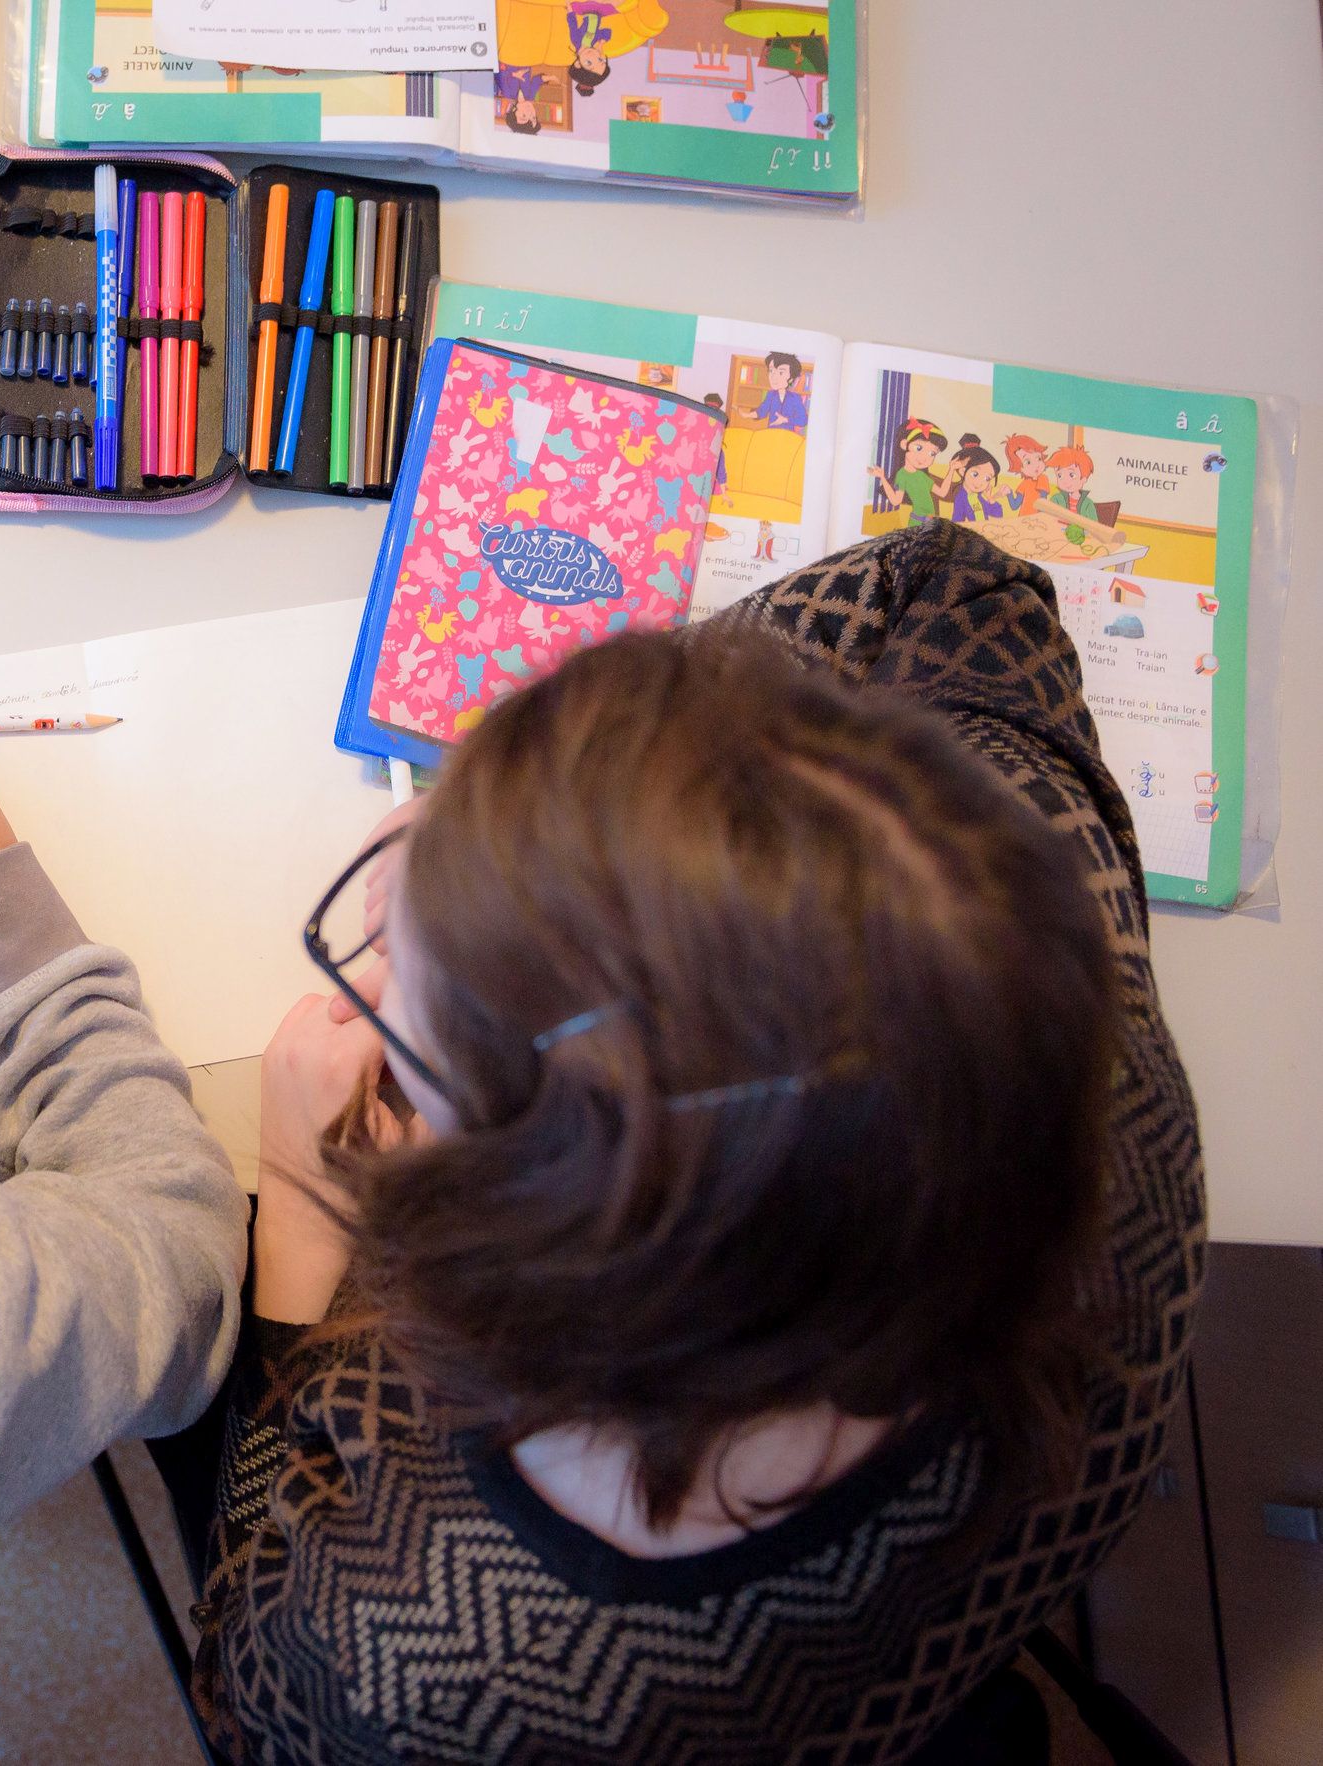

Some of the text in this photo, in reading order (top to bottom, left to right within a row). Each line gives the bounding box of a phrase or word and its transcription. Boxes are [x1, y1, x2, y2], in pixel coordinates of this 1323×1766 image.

[370, 45, 409, 56] timpului
[413, 45, 467, 54] Măsurarea
[123, 61, 194, 71] ANIMALELE
[124, 103, 136, 121] â
[1176, 410, 1188, 430] â
[1116, 457, 1189, 476] ANIMALELE
[1125, 475, 1179, 491] PROIECT
[479, 521, 587, 565] Curious
[705, 556, 763, 571] e-mi-si-u-ne
[508, 558, 618, 594] animals
[711, 569, 754, 583] emisiune
[1087, 640, 1168, 661] Mar-ta Tra-ian
[1087, 654, 1166, 673] Marta Traian
[1087, 693, 1115, 705] pictat
[1119, 697, 1136, 708] trei
[1156, 700, 1179, 713] Lâna
[1183, 704, 1197, 715] lor
[1200, 708, 1207, 717] e
[1093, 706, 1201, 728] cântec despre animale.
[1194, 883, 1209, 895] 65
